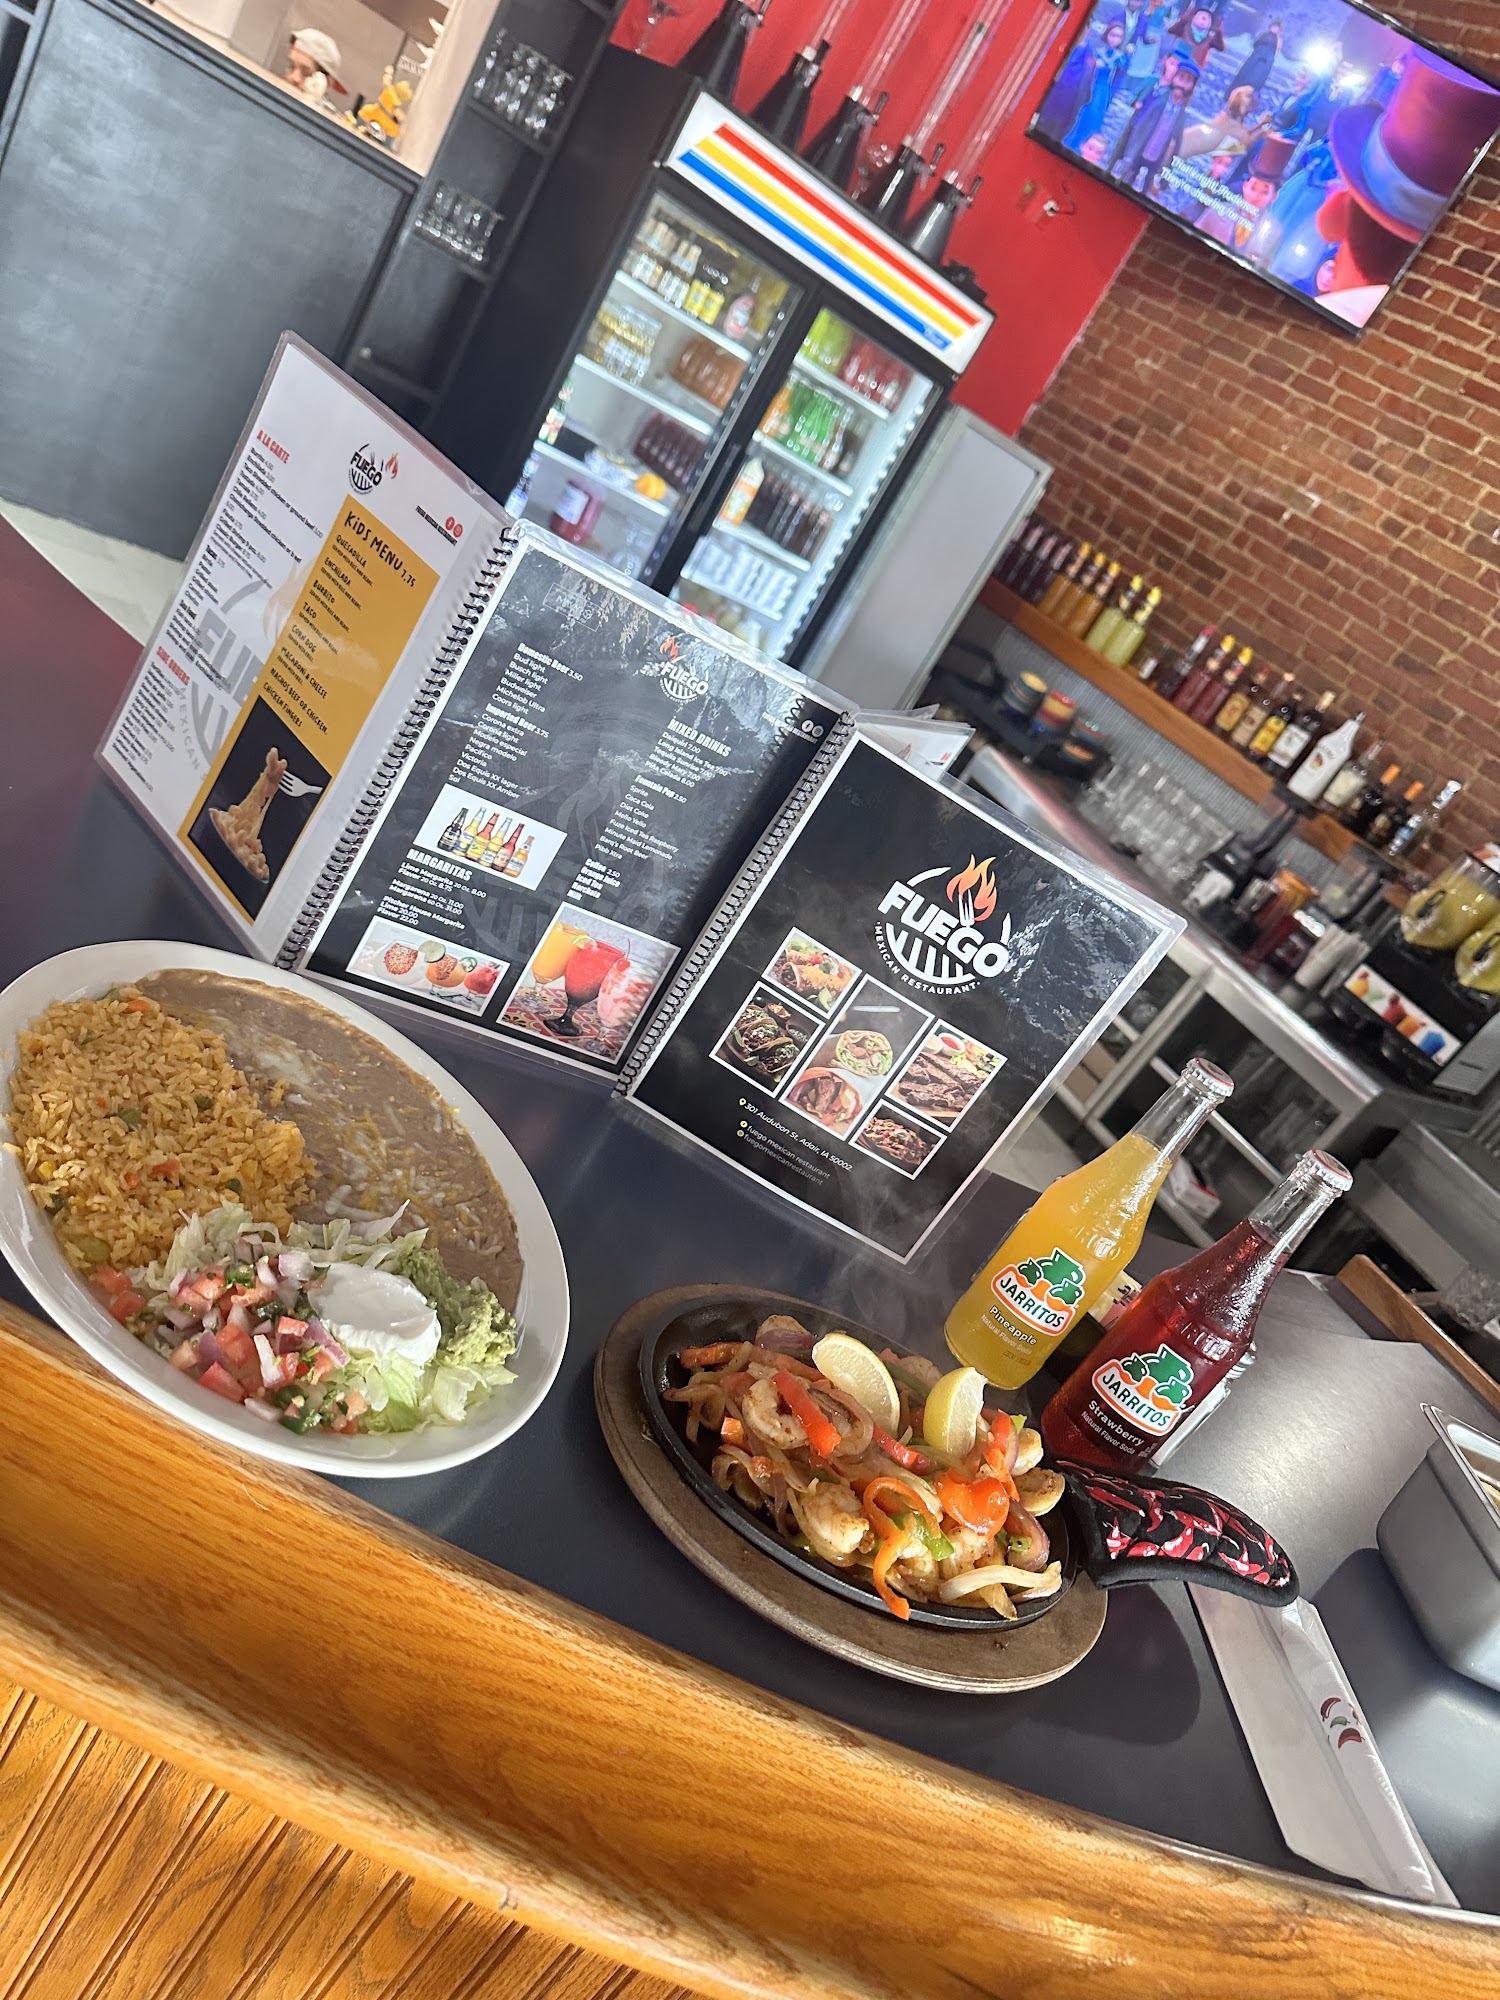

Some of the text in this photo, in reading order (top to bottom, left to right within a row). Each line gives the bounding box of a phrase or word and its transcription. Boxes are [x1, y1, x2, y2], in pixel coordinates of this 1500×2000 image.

[256, 429, 289, 463] A LA CARTE
[350, 451, 382, 485] FUEGO
[369, 536, 403, 570] MENU
[400, 568, 415, 587] 7.75
[302, 601, 316, 618] TACO
[291, 624, 306, 640] CORN
[304, 638, 316, 653] DOG
[508, 660, 548, 684] Busch light
[513, 652, 545, 673] Bud light
[517, 642, 583, 681] Domestic Beer 3.50
[270, 667, 290, 691] NACHOS
[288, 687, 300, 701] BEEF
[299, 700, 307, 710] OR
[309, 677, 327, 699] CHEESE
[500, 676, 537, 698] Budweiser
[504, 668, 541, 691] Miller light
[660, 662, 708, 694] FUEGO
[491, 693, 529, 714] Coors light
[496, 685, 545, 712] Michelob Ultra
[477, 720, 519, 743] Corona light
[481, 712, 524, 736] Corona extra
[485, 702, 549, 738] Imported Beer 3.75
[464, 743, 492, 759] Pacifico
[468, 736, 517, 761] Negra modelo
[473, 728, 527, 756] Modelo especial
[661, 731, 701, 753] Daiquiri 7.00
[667, 718, 731, 756] MIXED DRINKS
[461, 751, 487, 767] Victoria
[648, 753, 701, 781] Bloody Mary 7.00
[653, 745, 712, 778] Tequila Sunrise 7.00
[657, 738, 674, 751] Long
[673, 746, 694, 760] Island
[692, 755, 703, 764] Ice
[703, 760, 715, 770] Tea
[448, 773, 460, 782] Sol
[452, 766, 519, 798] Dos Equis XX Amber
[456, 758, 518, 789] Dos Equis XX lager
[659, 767, 680, 781] Colada
[680, 777, 695, 787] 8.00
[624, 793, 654, 810] Coca Cola
[629, 784, 648, 797] Sprite
[614, 809, 646, 828] Mello Yello
[619, 801, 649, 818] Diet Coke
[599, 835, 648, 859] Barq's Root Beer
[604, 826, 672, 860] Minute Maid Lemonade
[609, 818, 678, 853] Fuze Iced Tea Raspberry
[406, 848, 472, 880] MARGARITAS
[594, 843, 622, 859] Pibb Xtra
[397, 867, 421, 879] Flavor
[437, 882, 453, 892] 8.75
[400, 861, 420, 873] Lime
[419, 868, 453, 887] Margarita
[470, 888, 486, 898] 8.00
[606, 868, 620, 878] 2.50
[391, 878, 430, 897] Margarona
[447, 898, 464, 909] 11.00
[376, 906, 418, 925] Flavor 22.00
[379, 900, 418, 918] Lime 20.00
[382, 895, 465, 929] Pitcher House Margarita
[876, 880, 1008, 977] FUEGO
[873, 926, 976, 993] MEXICAN RESTAURANT
[744, 1102, 758, 1113] 301
[756, 1111, 789, 1134] Audubon
[788, 1131, 798, 1141] St,
[798, 1138, 820, 1154] Adair,
[820, 1150, 829, 1158] IA
[743, 1133, 824, 1185] fuegomexicanrestaurant
[746, 1125, 830, 1178] fuego mexican restaurant
[1000, 1277, 1064, 1326] JARRITOS
[980, 1313, 1031, 1355] Natural Flavor Soda
[989, 1305, 1037, 1345] Pineapple
[1103, 1373, 1170, 1426] JARRITOS
[1081, 1410, 1101, 1432] Natural
[1100, 1429, 1120, 1446] Flavor
[1119, 1442, 1136, 1455] Soda
[1088, 1399, 1144, 1445] Strawberry
